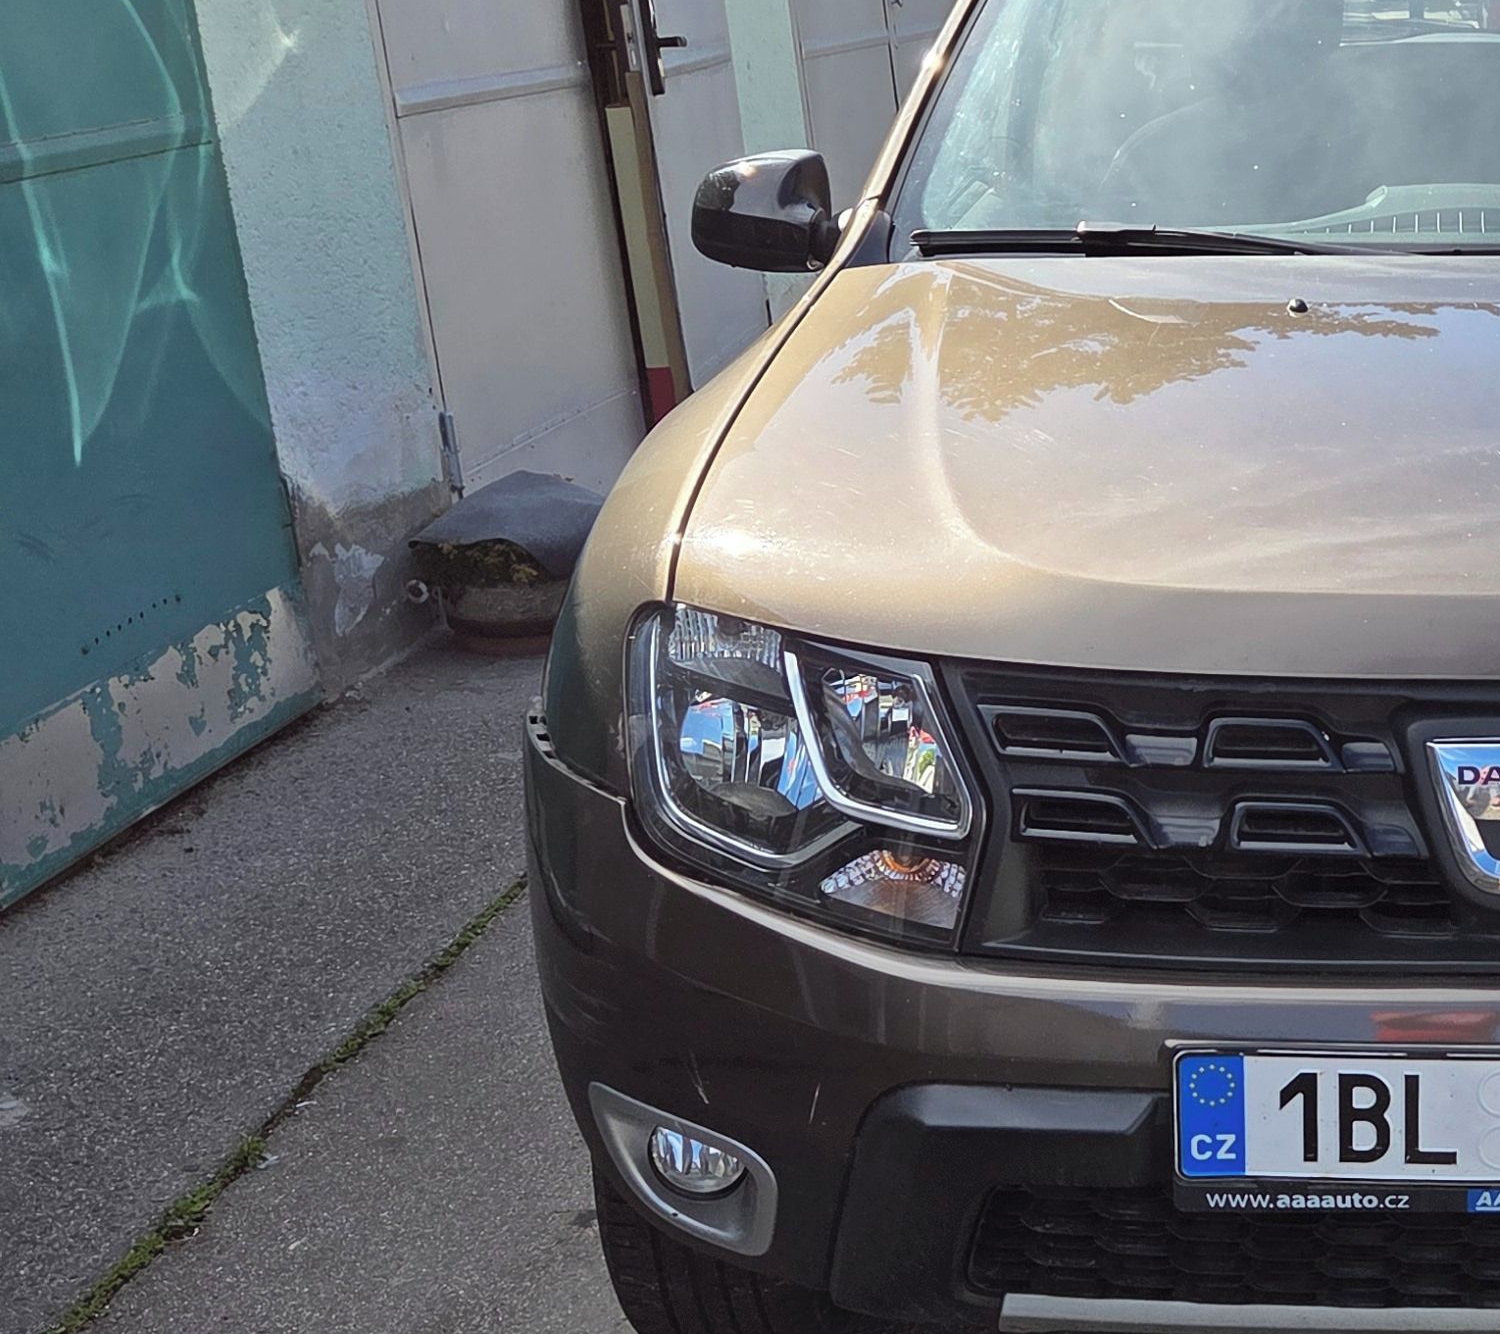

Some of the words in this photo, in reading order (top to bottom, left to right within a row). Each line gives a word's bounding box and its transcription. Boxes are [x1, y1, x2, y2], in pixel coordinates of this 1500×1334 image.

[1278, 1071, 1458, 1165] 1BL
[1189, 1134, 1237, 1161] CZ
[1206, 1192, 1410, 1209] www.aaaauto.cz
